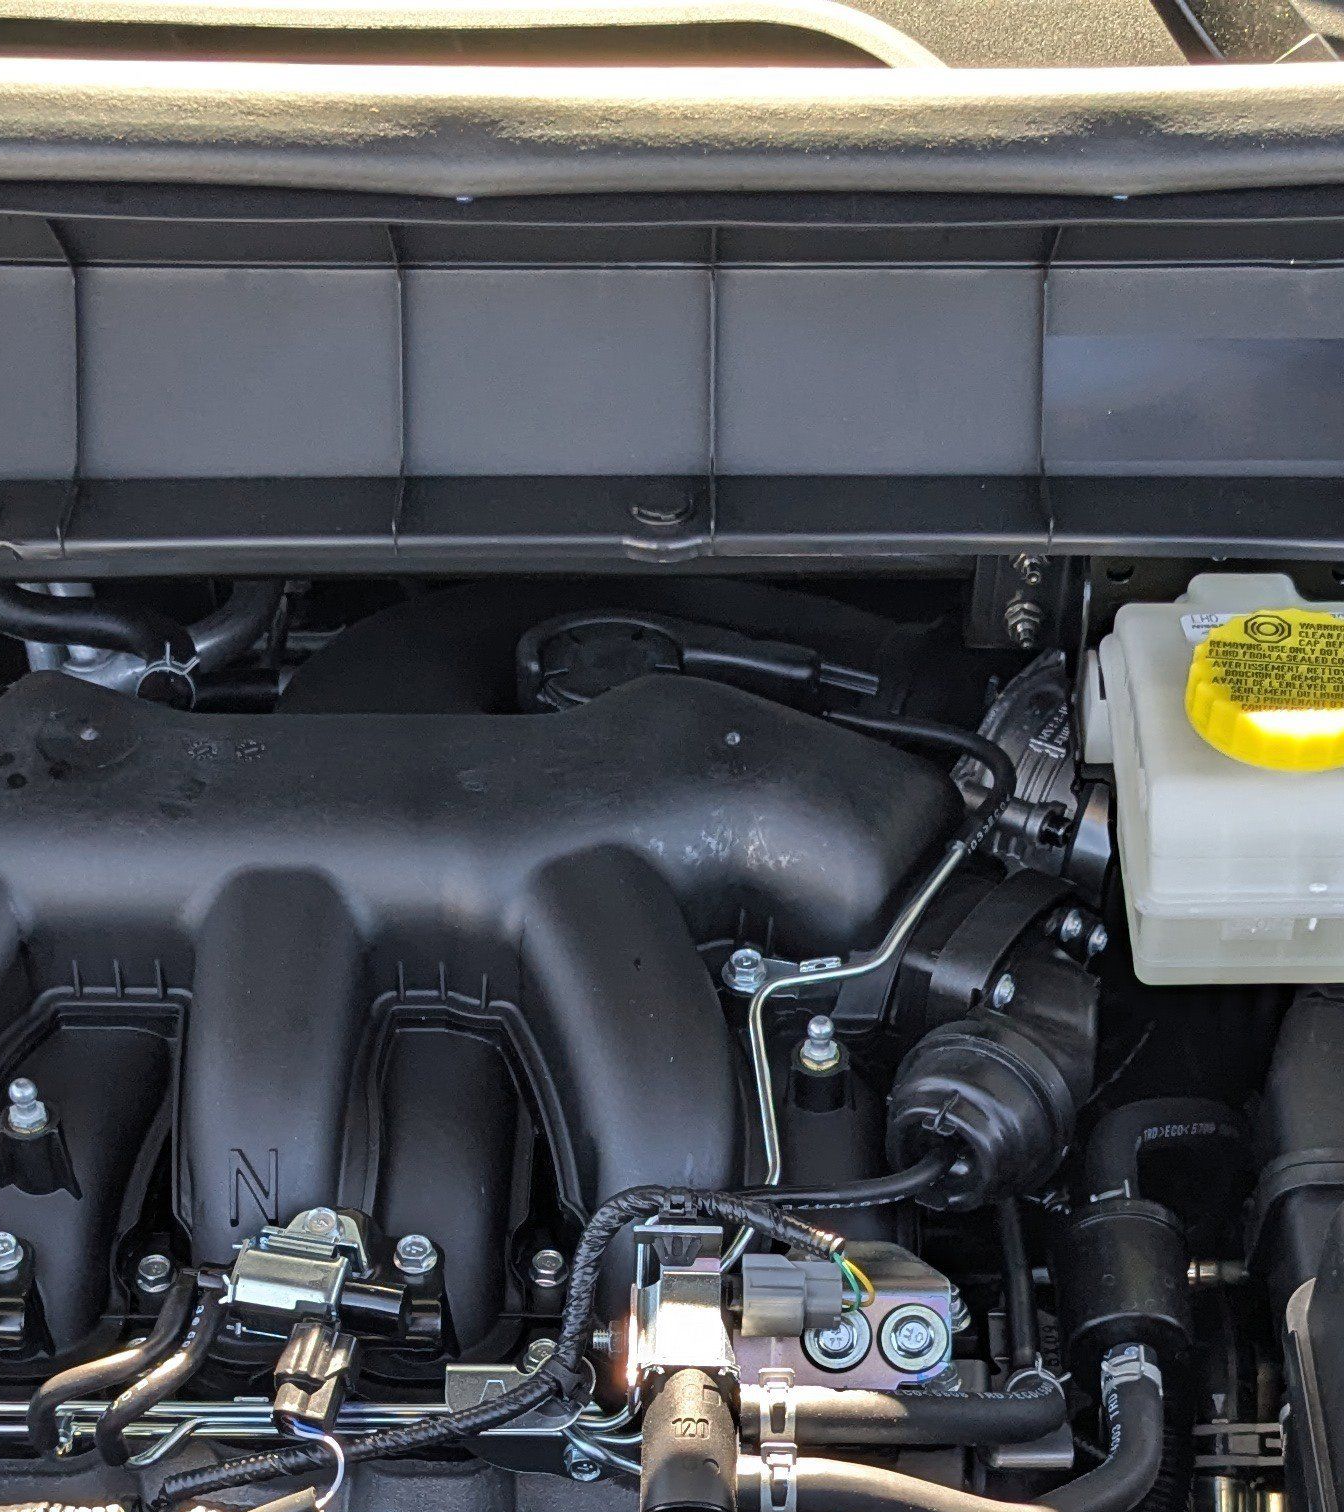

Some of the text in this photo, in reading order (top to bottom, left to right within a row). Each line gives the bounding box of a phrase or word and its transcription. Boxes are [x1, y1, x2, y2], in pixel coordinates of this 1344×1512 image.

[1298, 630, 1334, 640] CLEAN
[1298, 638, 1320, 648] CAP
[1267, 645, 1288, 654] USE
[1288, 646, 1316, 656] ONLY
[1319, 648, 1339, 657] DOT
[1242, 650, 1272, 660] FROM
[1275, 653, 1283, 662] A
[1285, 653, 1328, 665] SEALED
[229, 1148, 279, 1227] N
